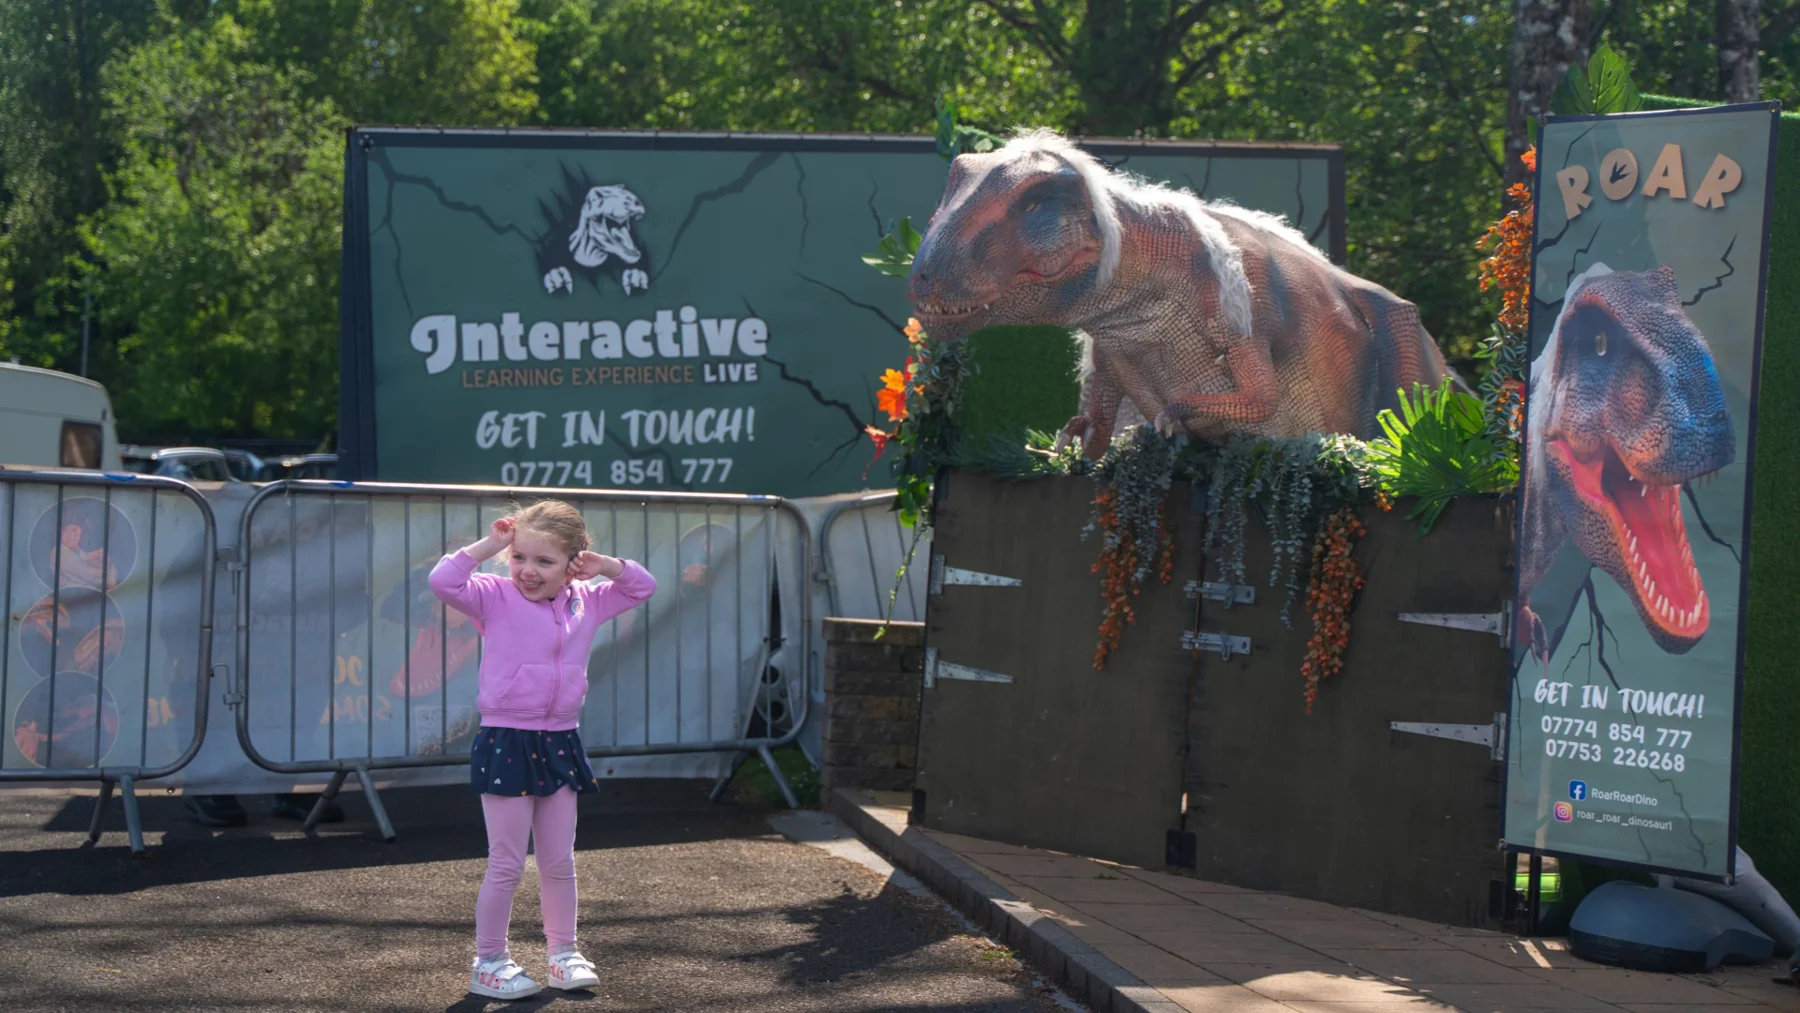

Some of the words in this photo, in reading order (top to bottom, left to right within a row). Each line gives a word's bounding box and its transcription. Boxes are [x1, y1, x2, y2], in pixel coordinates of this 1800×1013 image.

[1556, 143, 1742, 220] ROAR
[411, 306, 768, 374] Interactive
[462, 368, 564, 388] LEARNING
[572, 366, 694, 386] EXPERIENCE
[704, 362, 758, 383] LIVE
[475, 410, 546, 449] GET
[562, 410, 605, 446] IN
[621, 407, 755, 446] TOUCH!
[501, 461, 592, 486] 07774
[610, 459, 664, 484] 854
[681, 458, 733, 483] 777
[1534, 679, 1573, 707] GET
[1580, 685, 1608, 710] IN
[1617, 688, 1705, 719] TOUCH!
[1541, 715, 1597, 739] 07774
[1609, 723, 1645, 744] 854
[1656, 728, 1692, 749] 777
[1545, 739, 1602, 762] 07753
[1613, 747, 1685, 772] 226268
[1591, 788, 1658, 806] RoarRoarDino
